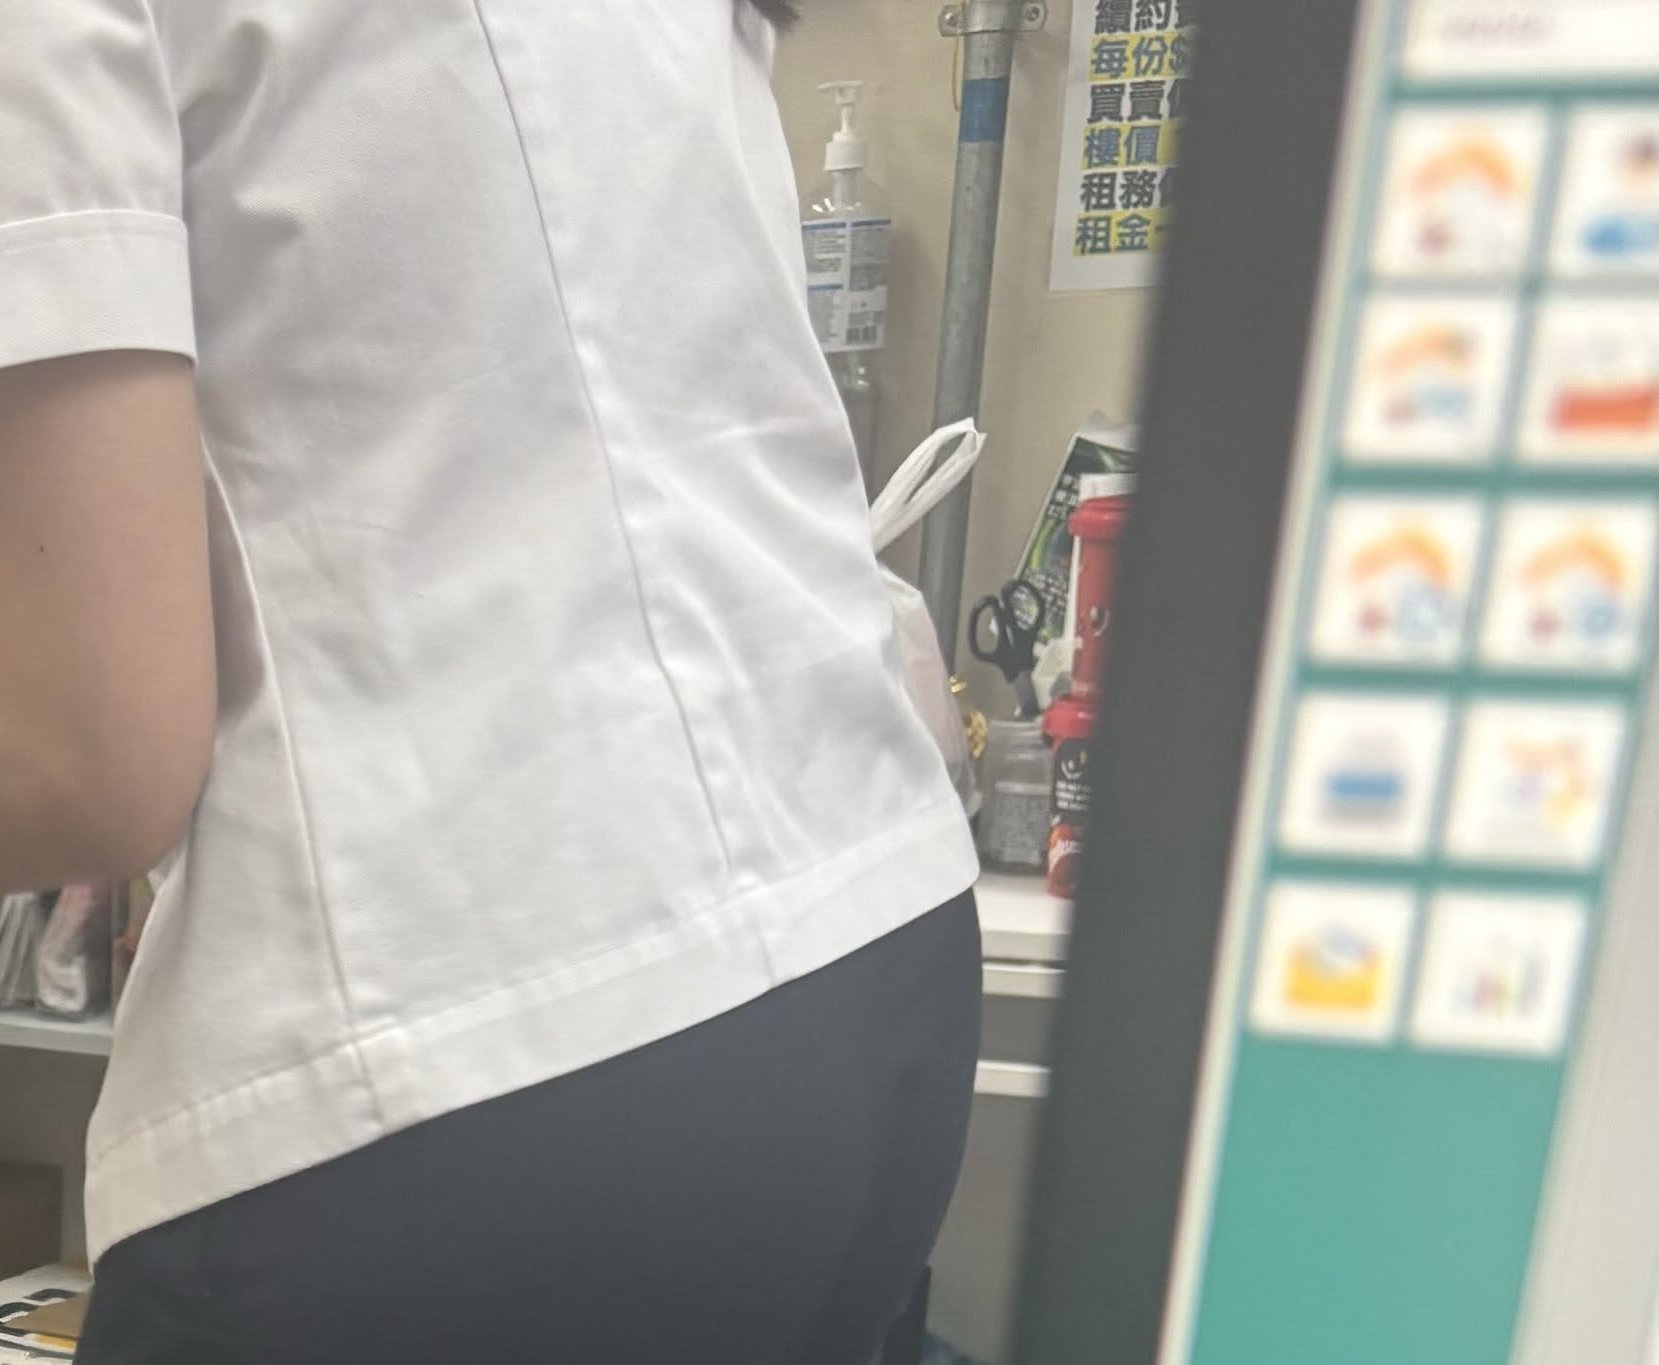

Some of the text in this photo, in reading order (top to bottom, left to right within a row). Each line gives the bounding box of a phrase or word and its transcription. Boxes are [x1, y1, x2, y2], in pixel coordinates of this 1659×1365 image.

[1094, 0, 1192, 34] 續約
[1080, 169, 1172, 213] 租務
[1075, 213, 1164, 255] 租金
